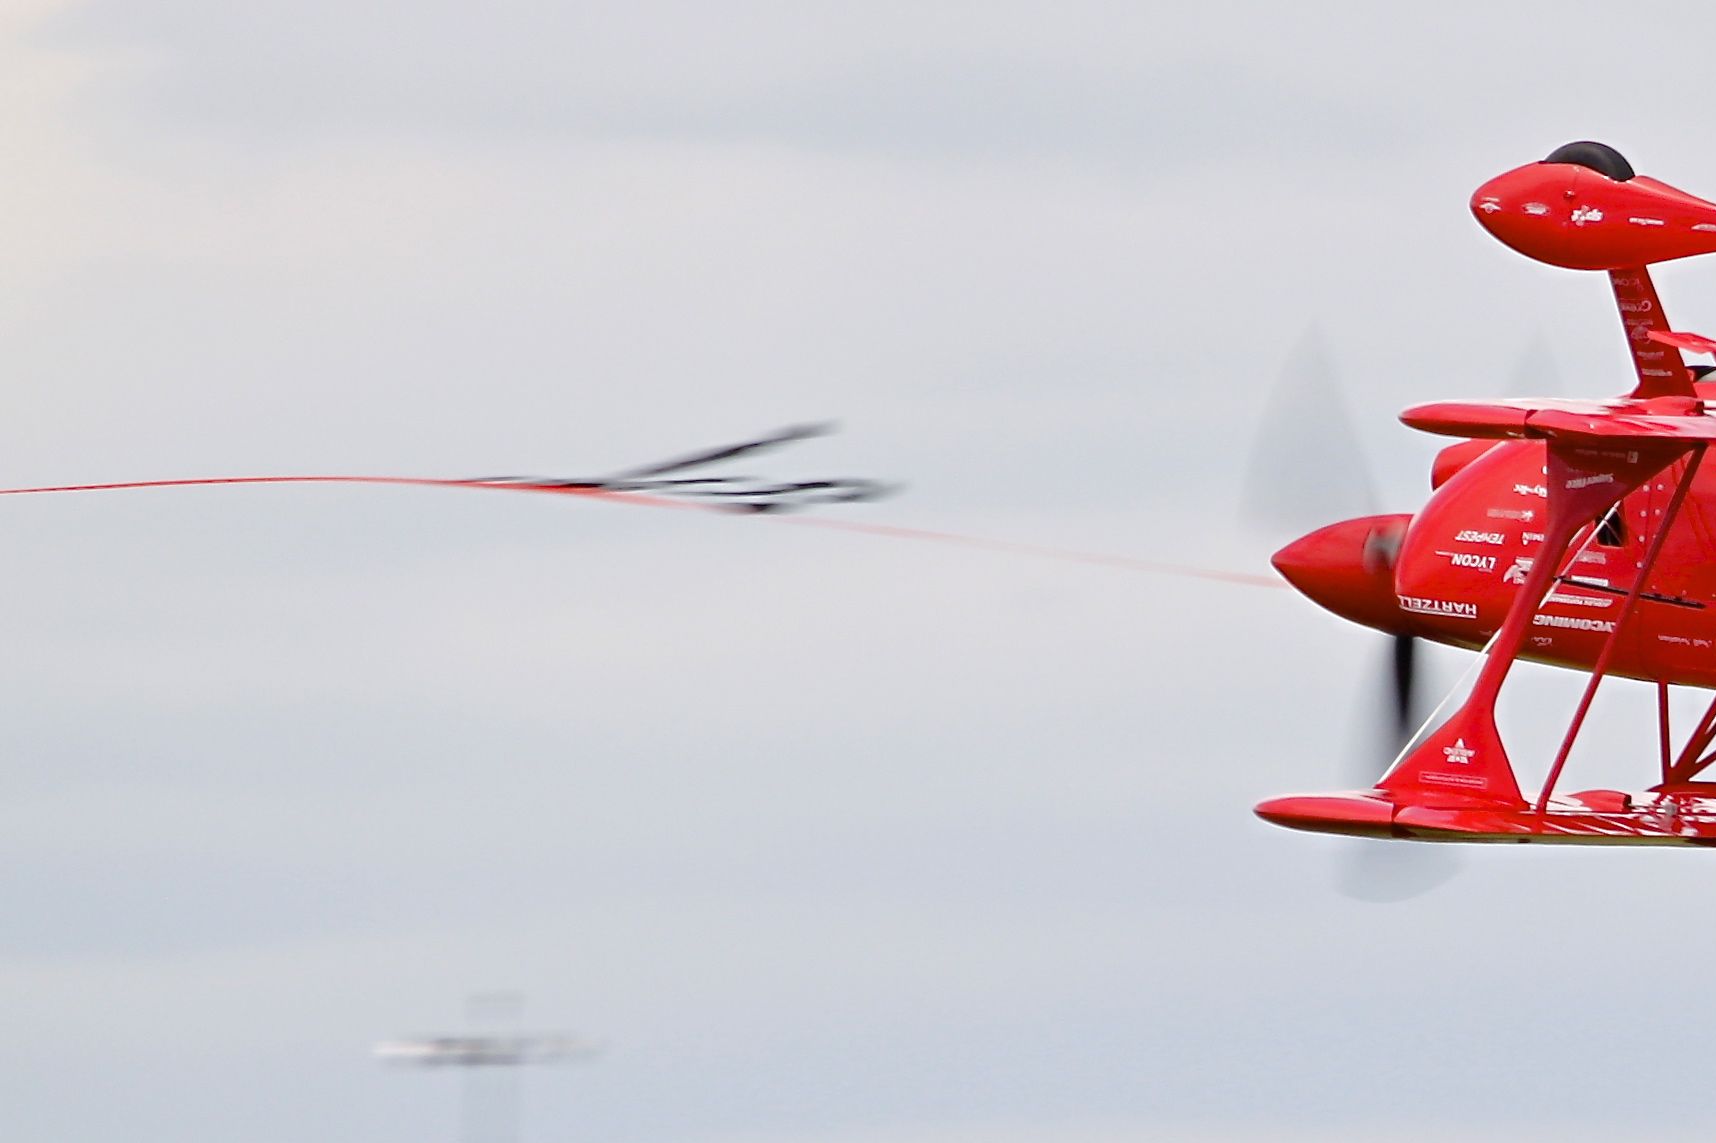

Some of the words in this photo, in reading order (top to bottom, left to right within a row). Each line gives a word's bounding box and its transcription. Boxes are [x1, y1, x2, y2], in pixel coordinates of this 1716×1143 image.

[1454, 530, 1505, 545] TEMPEST
[1454, 553, 1497, 570] LYCON
[1397, 594, 1478, 615] HARTZELL
